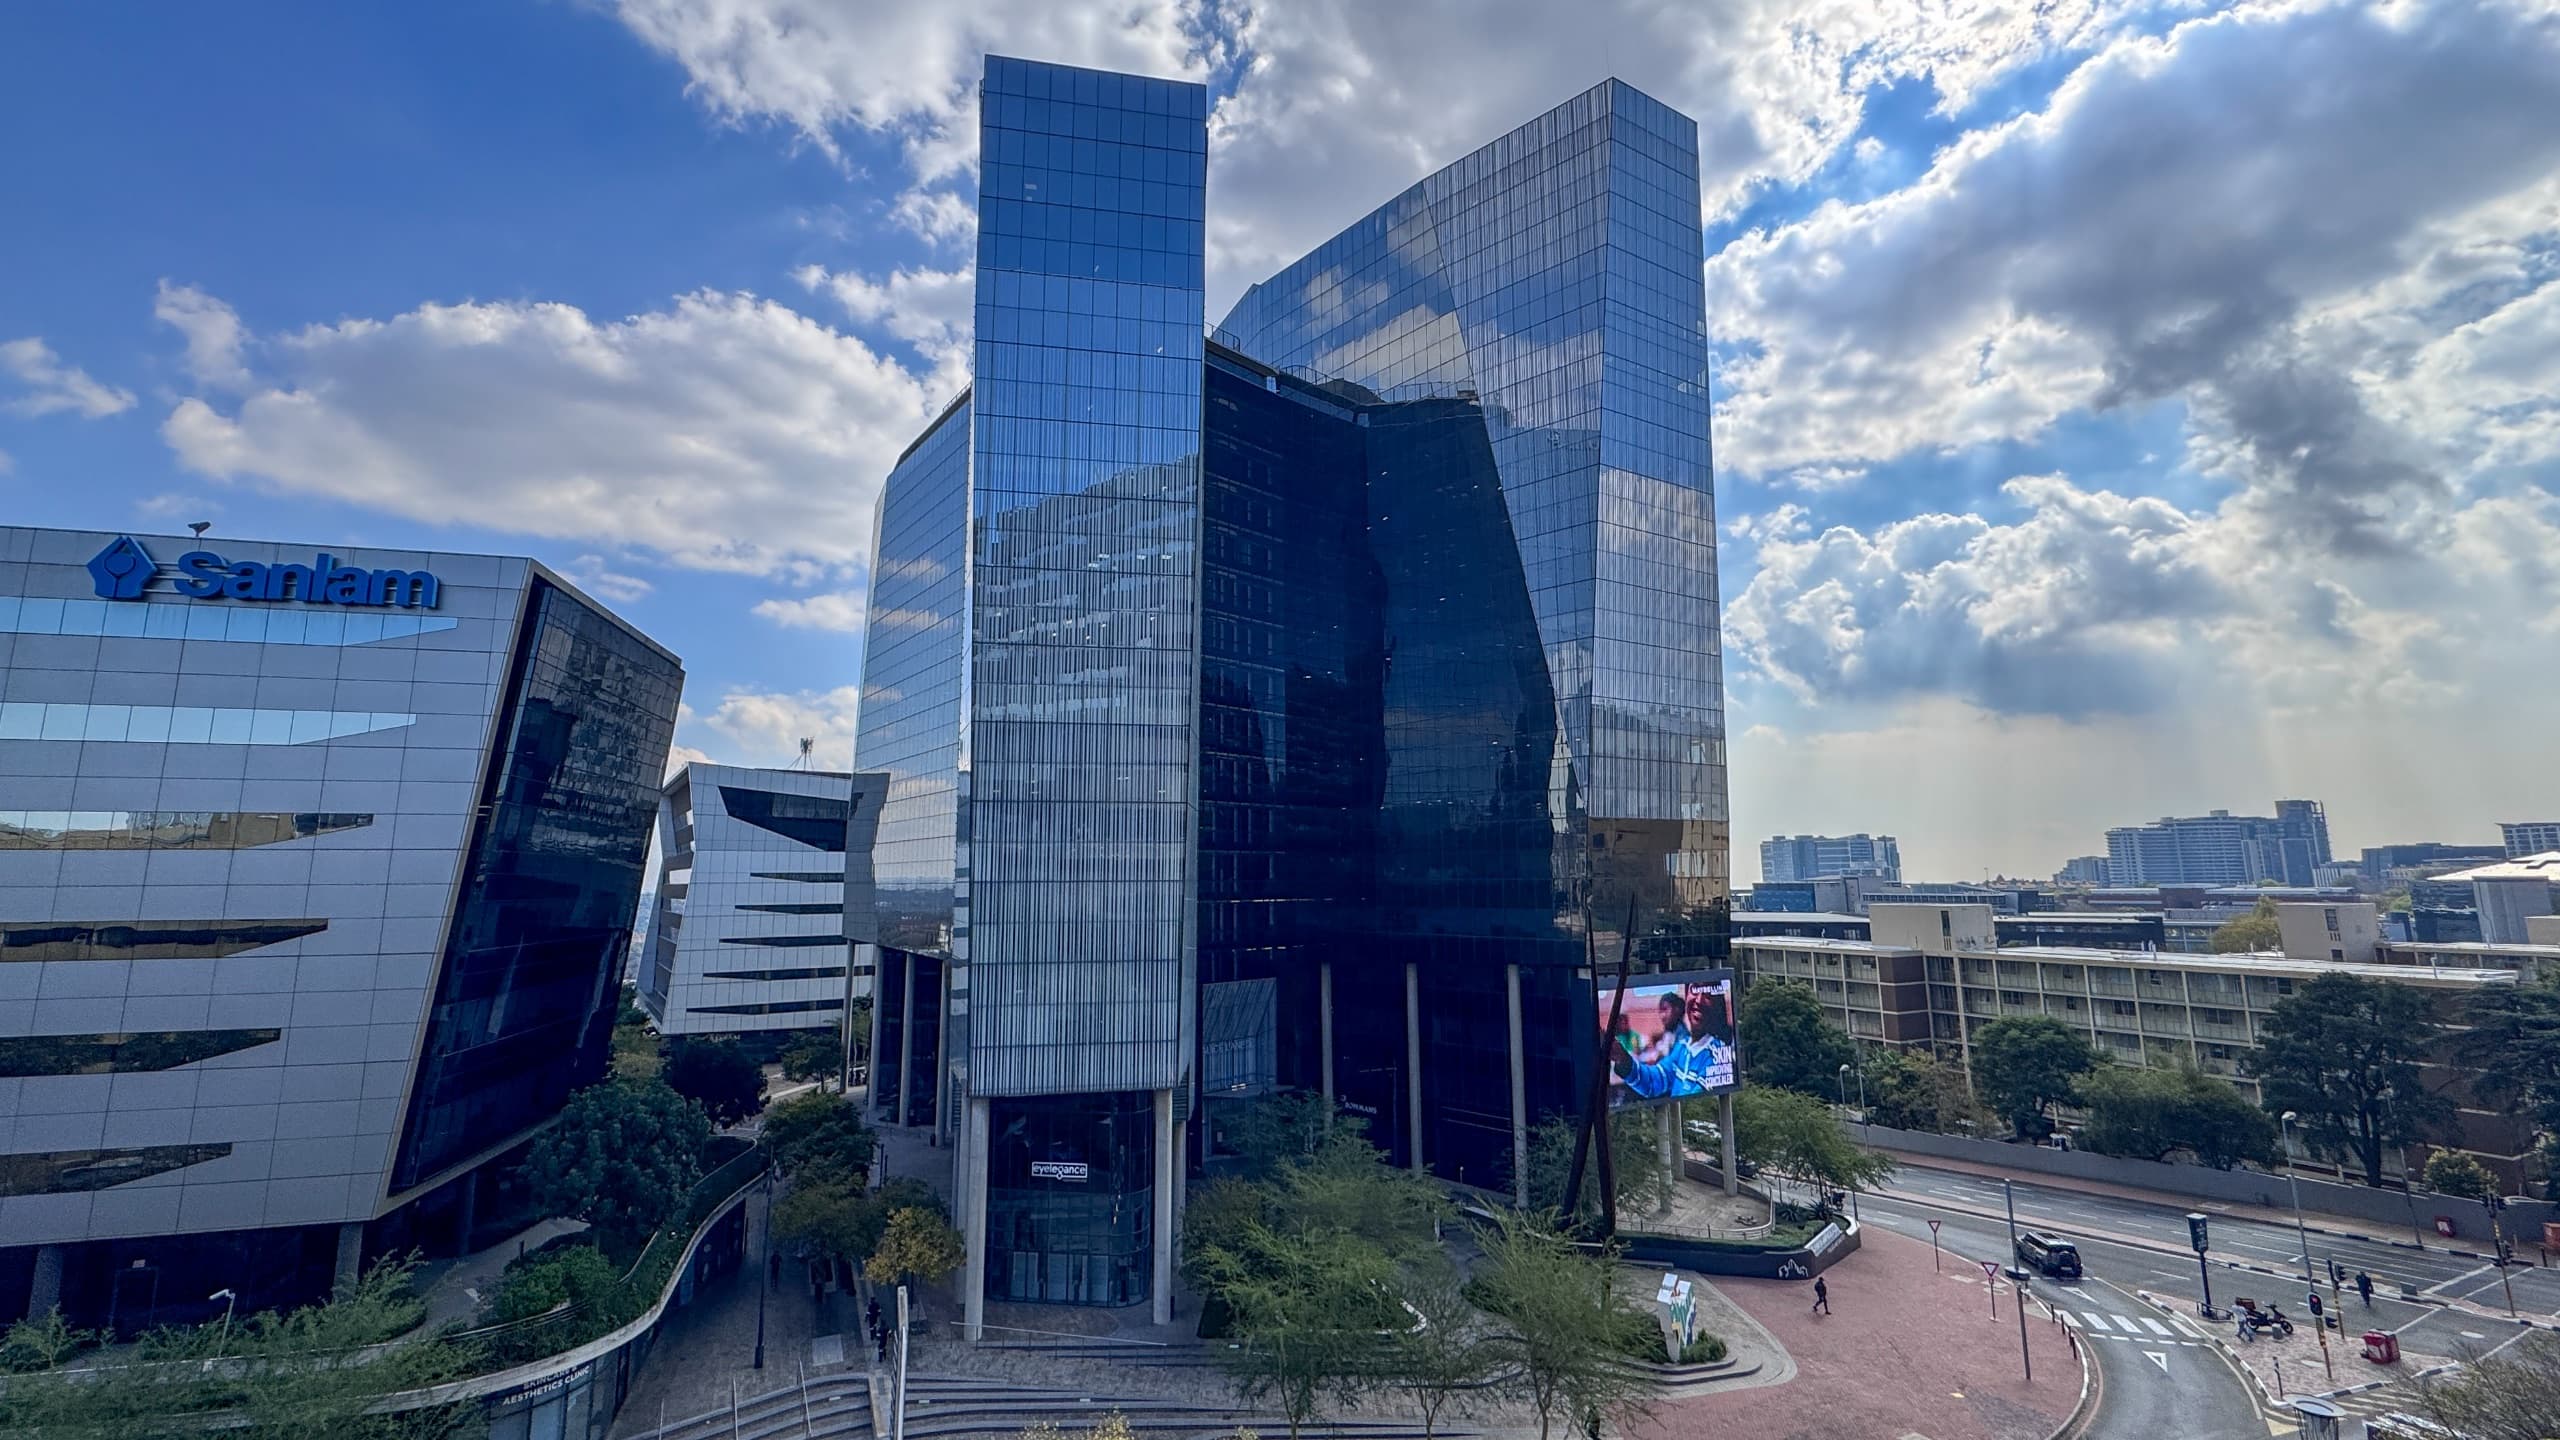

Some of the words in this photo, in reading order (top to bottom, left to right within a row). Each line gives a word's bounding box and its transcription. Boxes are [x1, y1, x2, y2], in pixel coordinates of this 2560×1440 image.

[174, 551, 440, 609] Sanlam
[1712, 1046, 1732, 1065] SKIN
[1032, 1163, 1087, 1180] eyelegance
[502, 1379, 564, 1406] AESTHETICS
[564, 1364, 591, 1384] CLINIC
